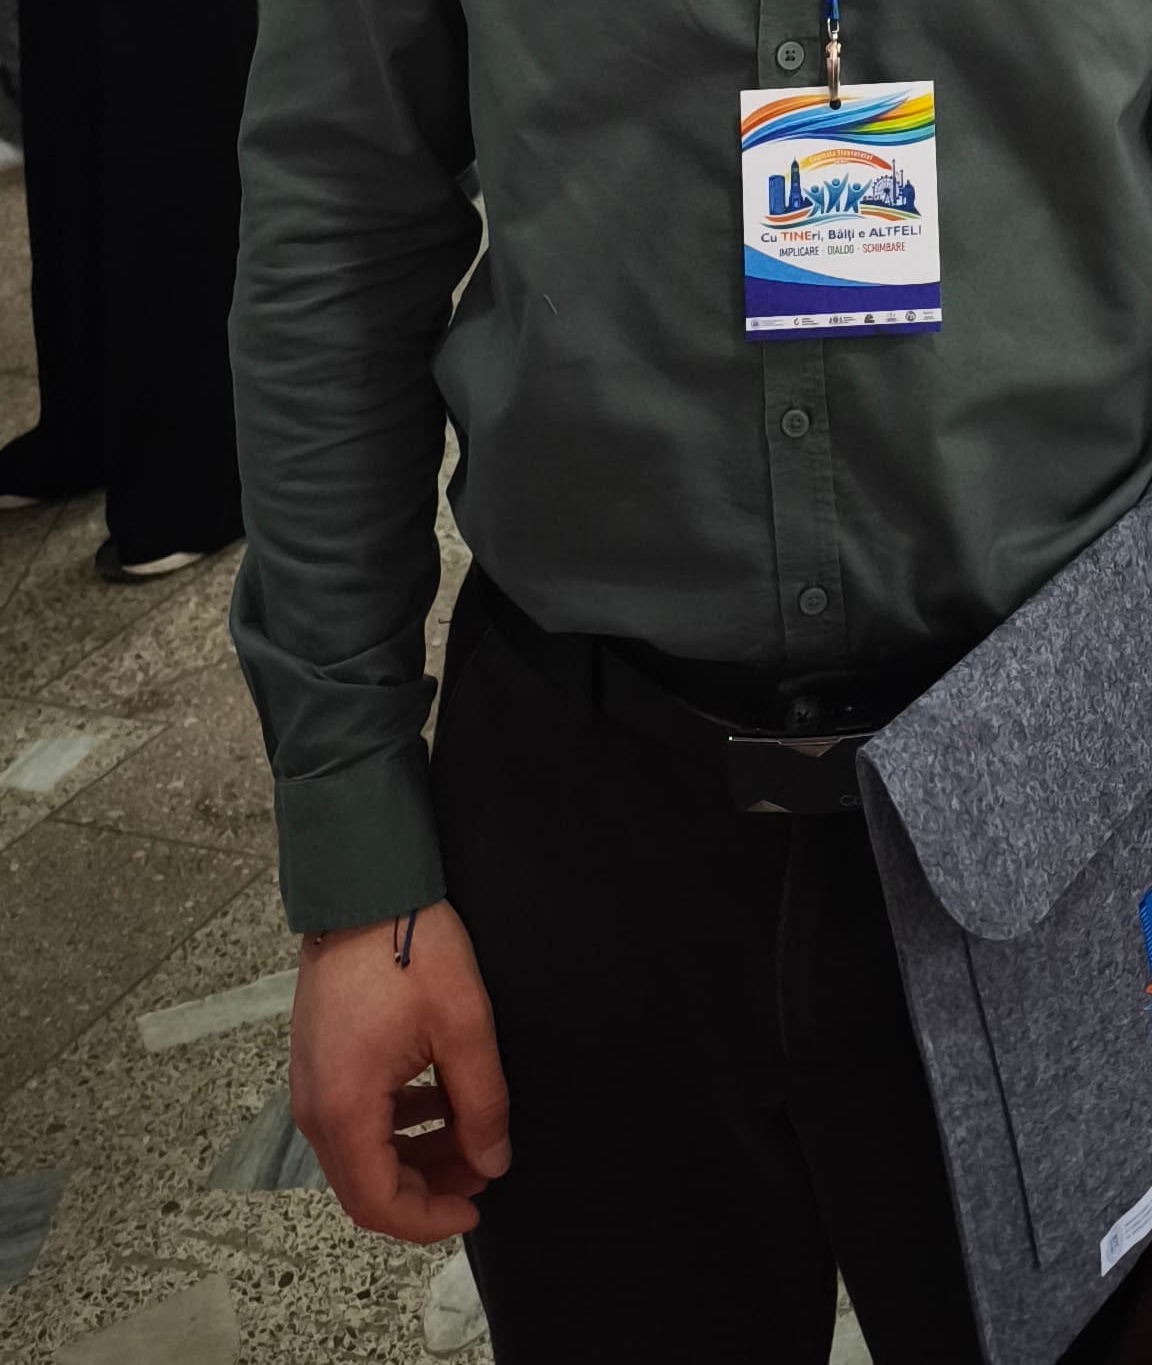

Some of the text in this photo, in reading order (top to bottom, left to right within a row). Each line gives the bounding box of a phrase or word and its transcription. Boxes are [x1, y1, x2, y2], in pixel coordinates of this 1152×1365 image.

[761, 232, 777, 243] Cu
[858, 230, 866, 238] e
[779, 246, 820, 257] IMPLICARE
[862, 241, 906, 254] SCHIMBARE
